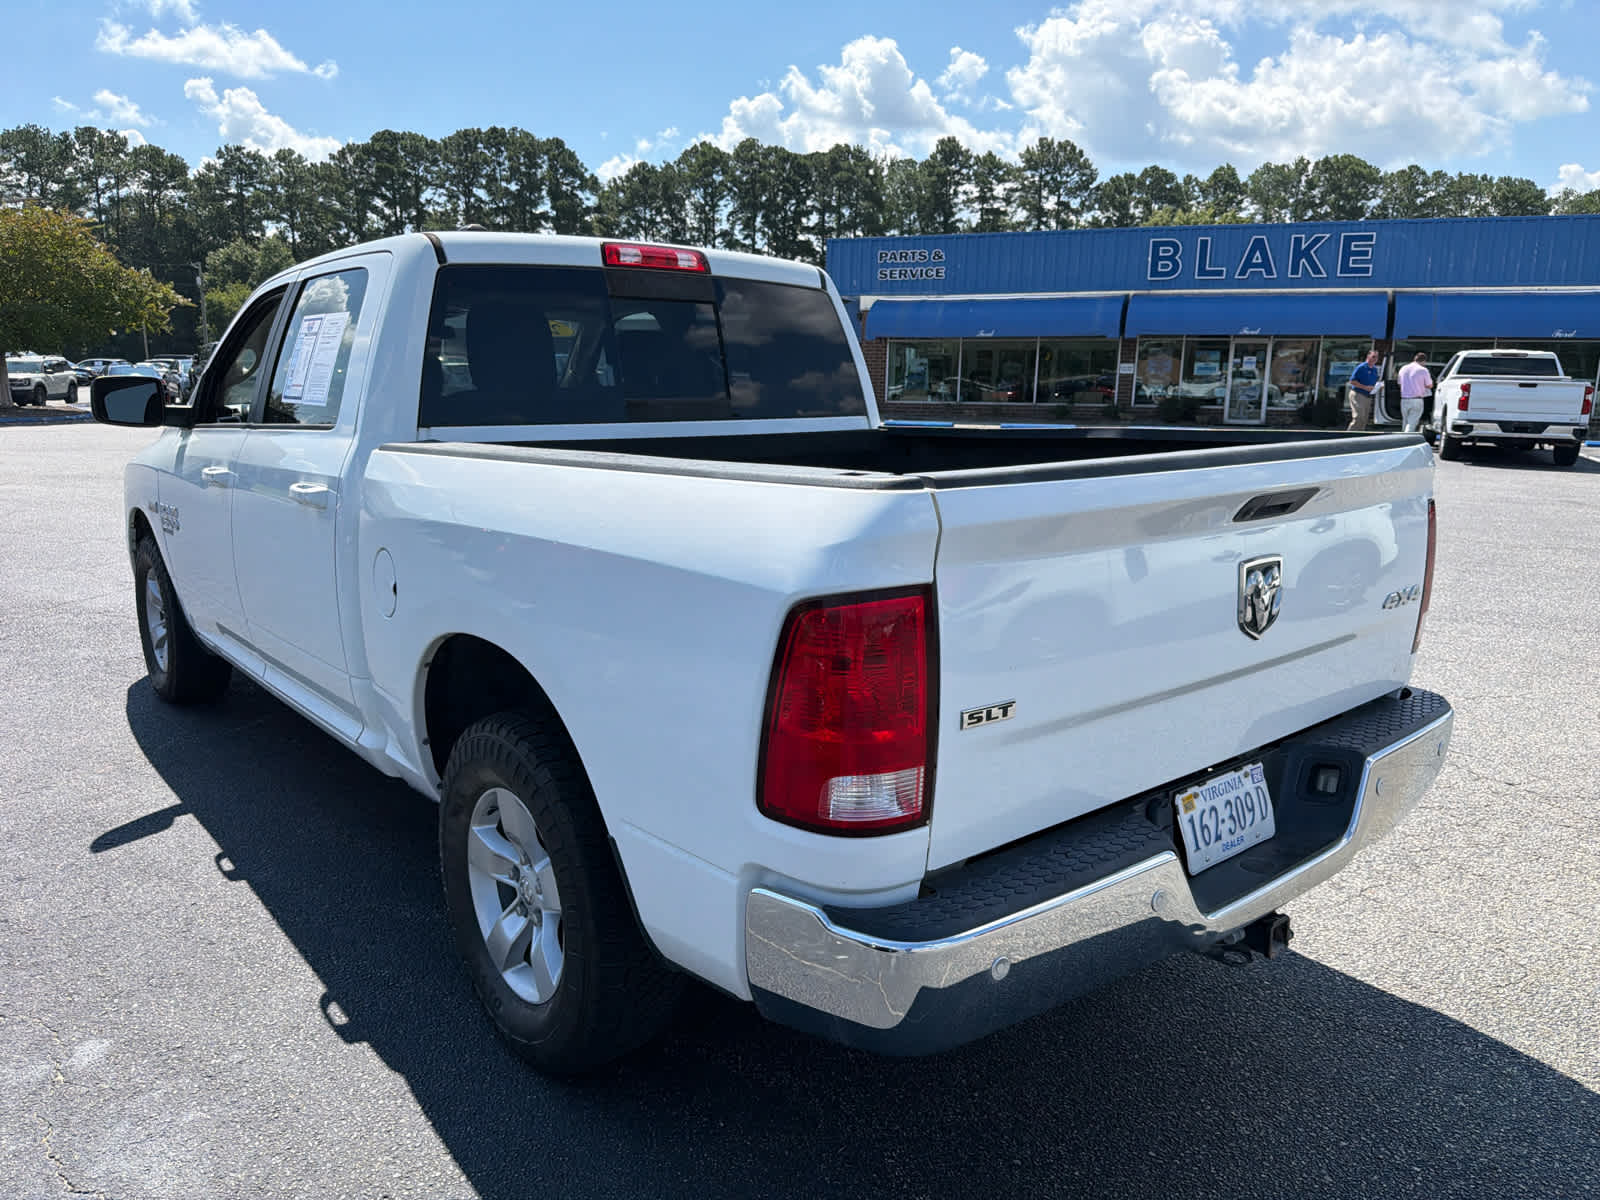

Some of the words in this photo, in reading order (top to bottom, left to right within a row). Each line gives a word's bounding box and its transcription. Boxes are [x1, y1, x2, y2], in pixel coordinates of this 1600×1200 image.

[878, 249, 928, 264] PARTS
[931, 248, 945, 262] &
[1147, 231, 1377, 281] BLAKE
[878, 266, 945, 280] SERVICE
[966, 703, 1014, 726] SLT
[1200, 774, 1244, 802] VIRGINIA
[1222, 835, 1245, 852] DEALER
